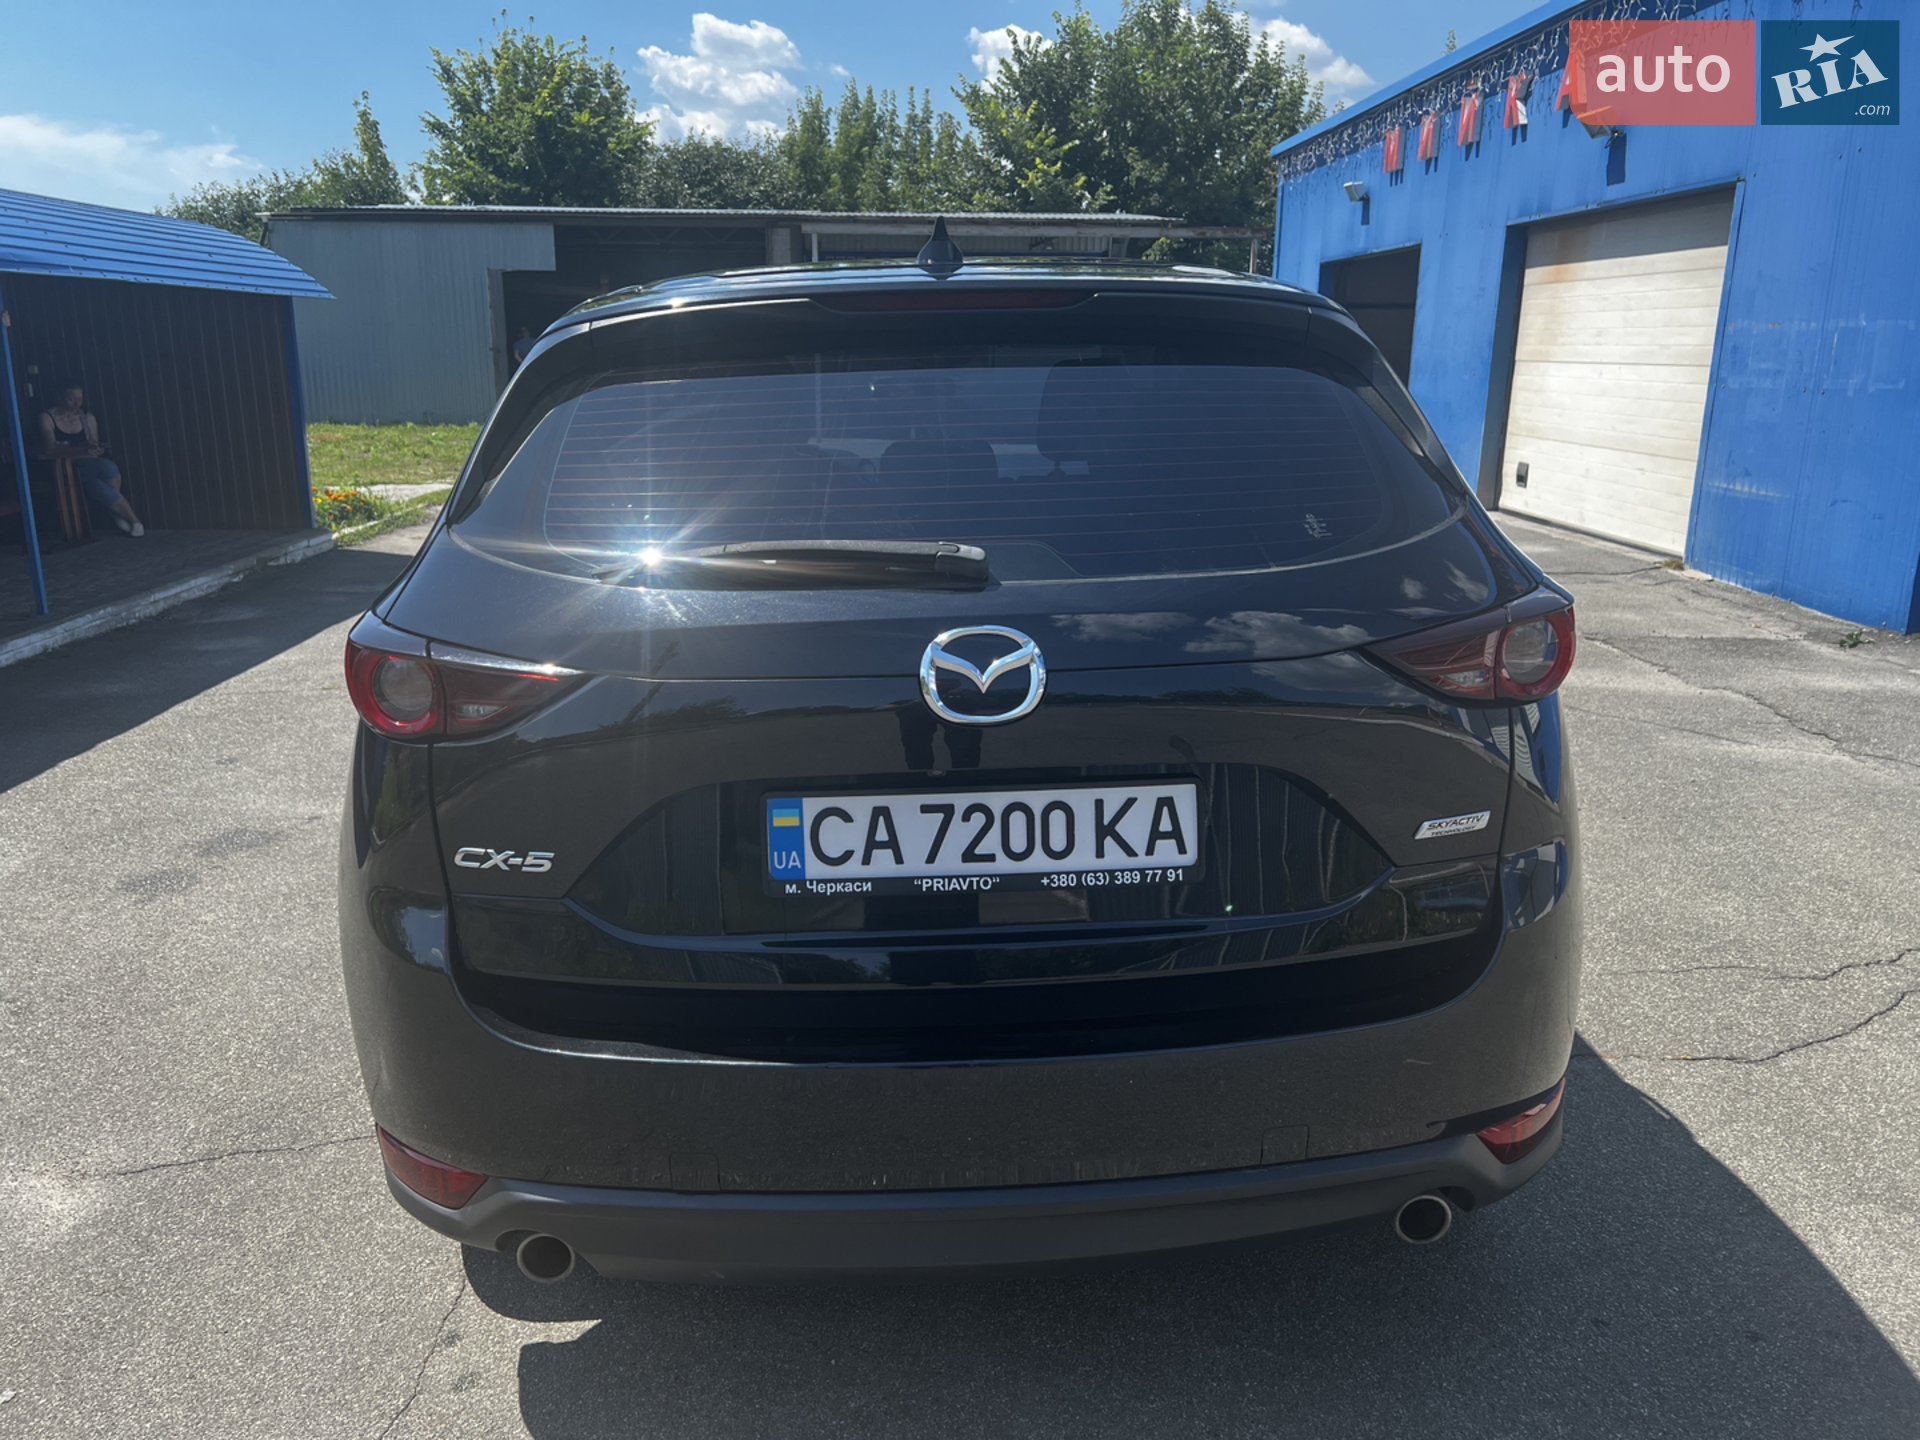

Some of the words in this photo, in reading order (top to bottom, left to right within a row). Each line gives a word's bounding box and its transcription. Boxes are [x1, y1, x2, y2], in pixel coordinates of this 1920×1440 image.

[809, 805, 905, 867] CA
[919, 799, 1076, 865] 7200
[1093, 795, 1188, 860] KA
[1426, 813, 1485, 831] SKYACTIV
[453, 847, 556, 873] CX-5
[773, 851, 802, 870] UA
[785, 884, 802, 895] м.
[806, 879, 873, 896] Черкаси
[1040, 873, 1077, 888] +380
[1081, 871, 1110, 887] (63)
[1114, 870, 1141, 885] 389
[1145, 869, 1163, 883] 77
[1166, 868, 1184, 882] 91
